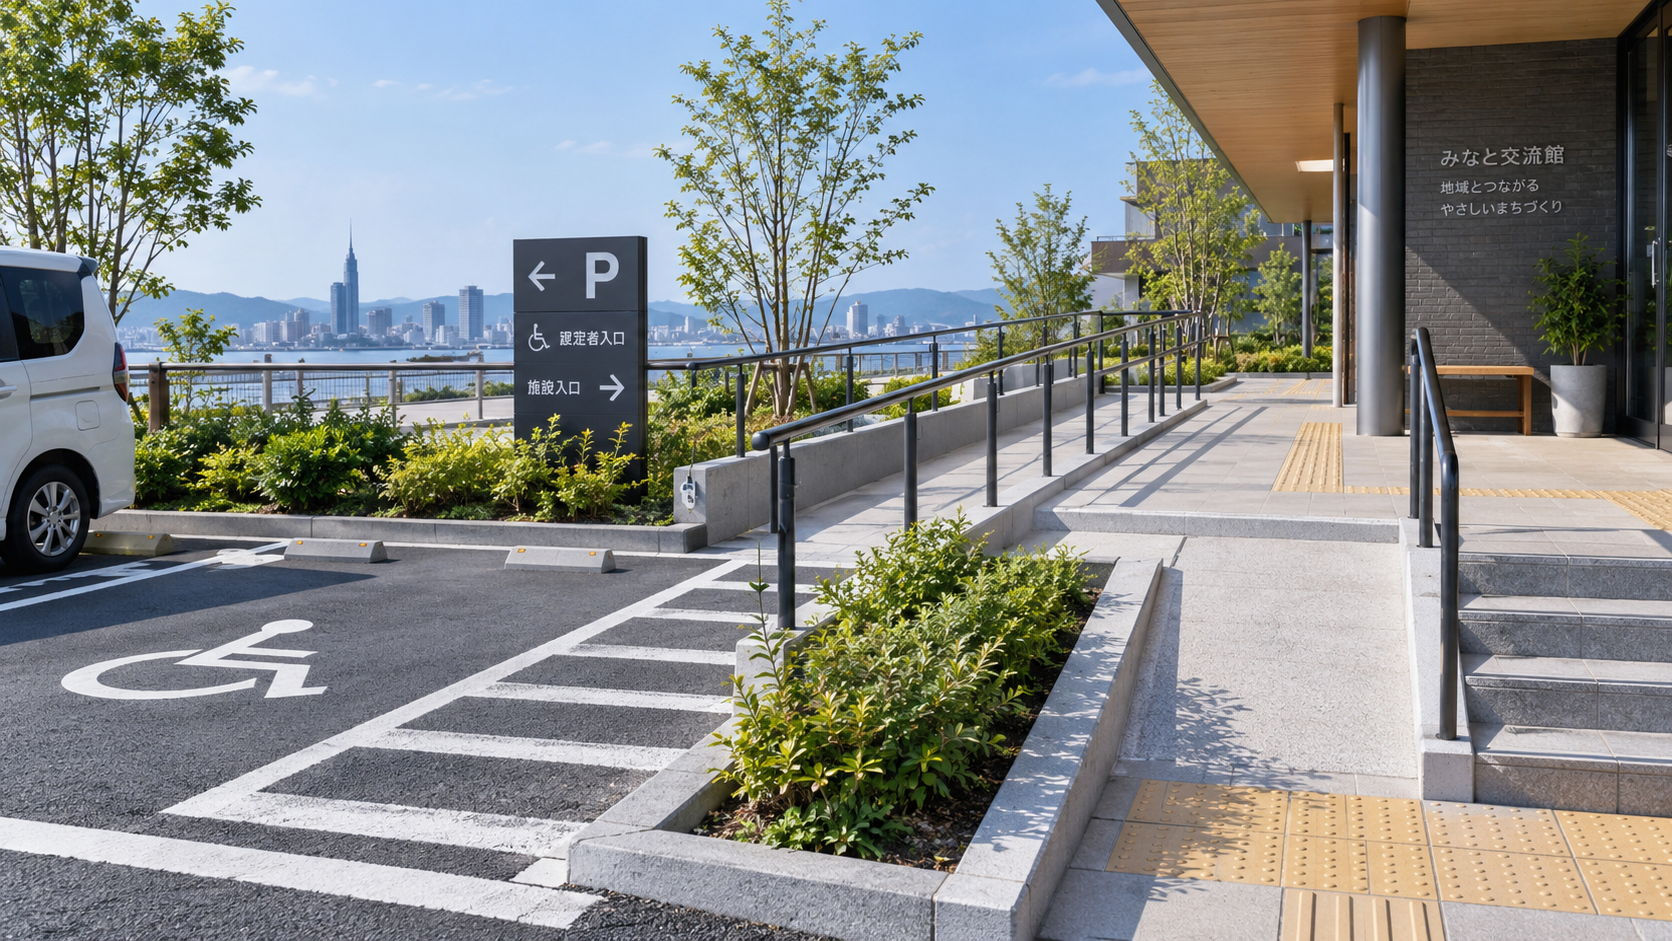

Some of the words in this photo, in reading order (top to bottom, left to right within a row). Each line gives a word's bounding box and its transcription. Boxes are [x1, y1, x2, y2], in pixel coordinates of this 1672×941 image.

[1440, 145, 1565, 167] みなと交流館
[1440, 178, 1539, 195] 地域とつながる
[1440, 200, 1563, 217] やさしいまちづくり
[586, 252, 619, 299] P
[527, 379, 581, 396] 施設入口
